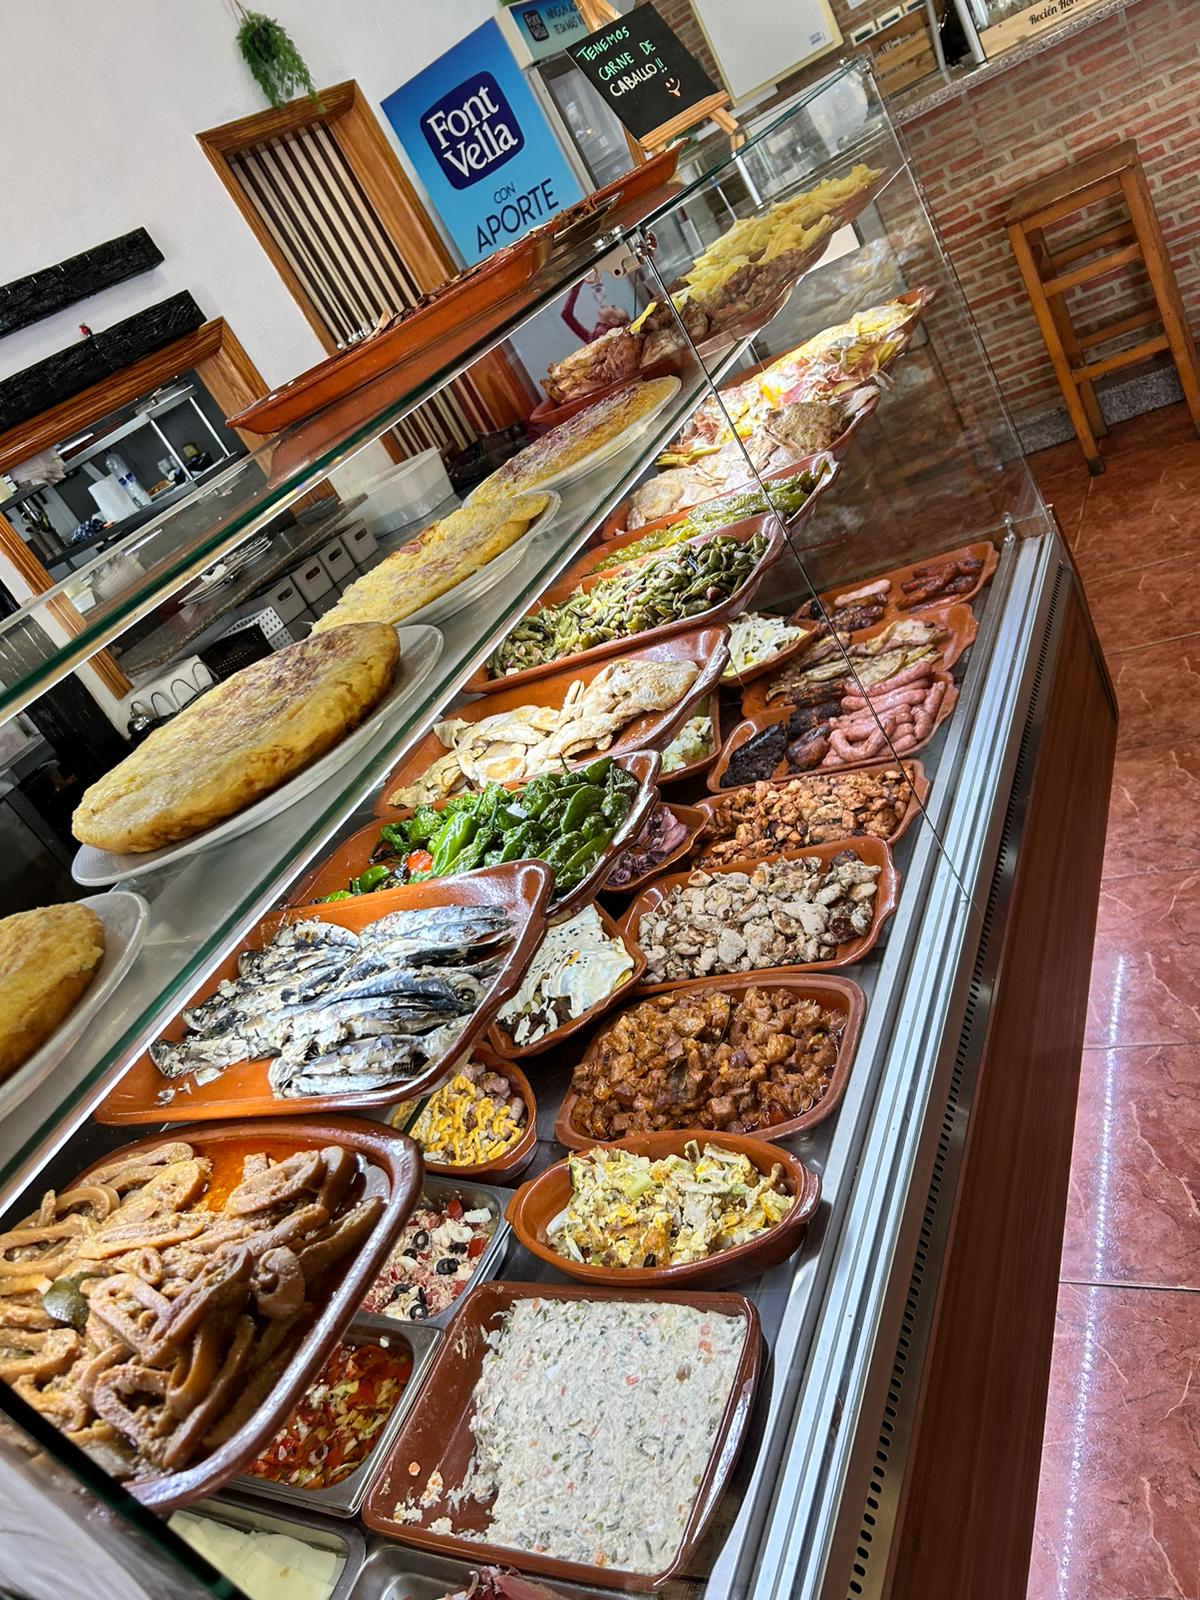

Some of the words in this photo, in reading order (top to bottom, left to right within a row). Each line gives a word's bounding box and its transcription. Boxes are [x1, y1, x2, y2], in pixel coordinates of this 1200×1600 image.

[1029, 6, 1058, 25] Recién
[576, 26, 630, 61] TENEMOS
[598, 52, 635, 81] CARNE
[639, 39, 656, 55] DE
[426, 85, 499, 150] Font
[443, 122, 519, 178] Vella
[493, 182, 516, 205] CON
[476, 178, 560, 254] APORTE
